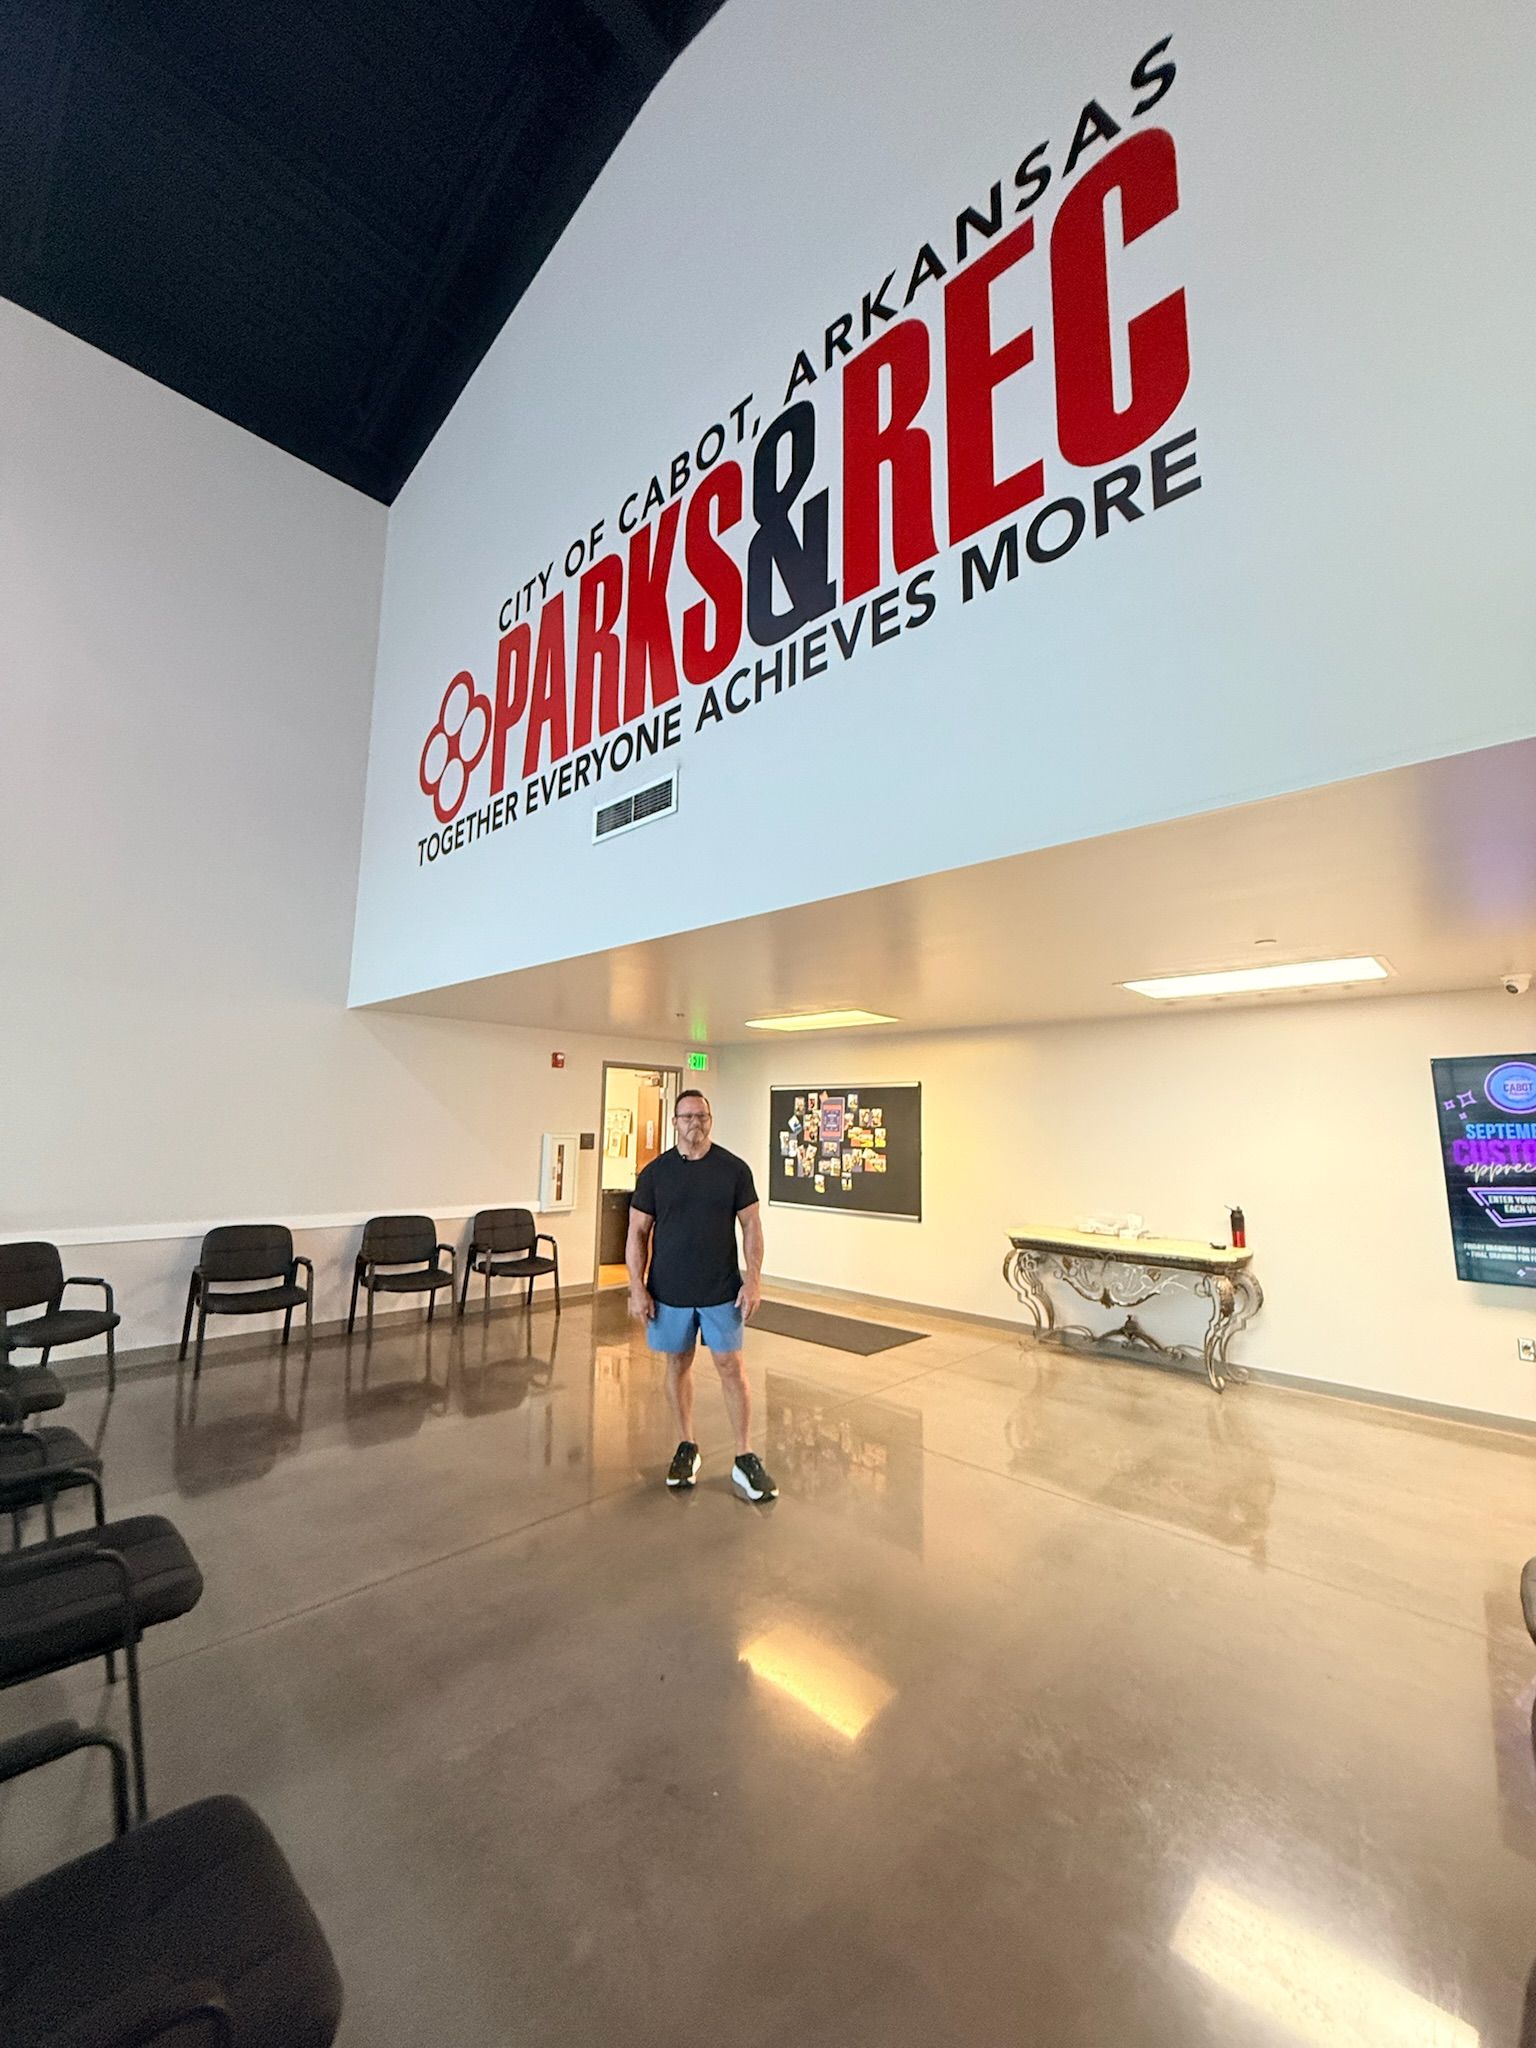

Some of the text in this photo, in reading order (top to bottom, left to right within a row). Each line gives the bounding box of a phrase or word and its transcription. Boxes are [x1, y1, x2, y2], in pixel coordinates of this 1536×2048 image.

[498, 34, 1177, 632] CITY OF CABOT, ARKANSAS
[418, 427, 1202, 866] TOGETHER EVERYONE ACHIEVES MORE
[1503, 1083, 1533, 1094] CABOT
